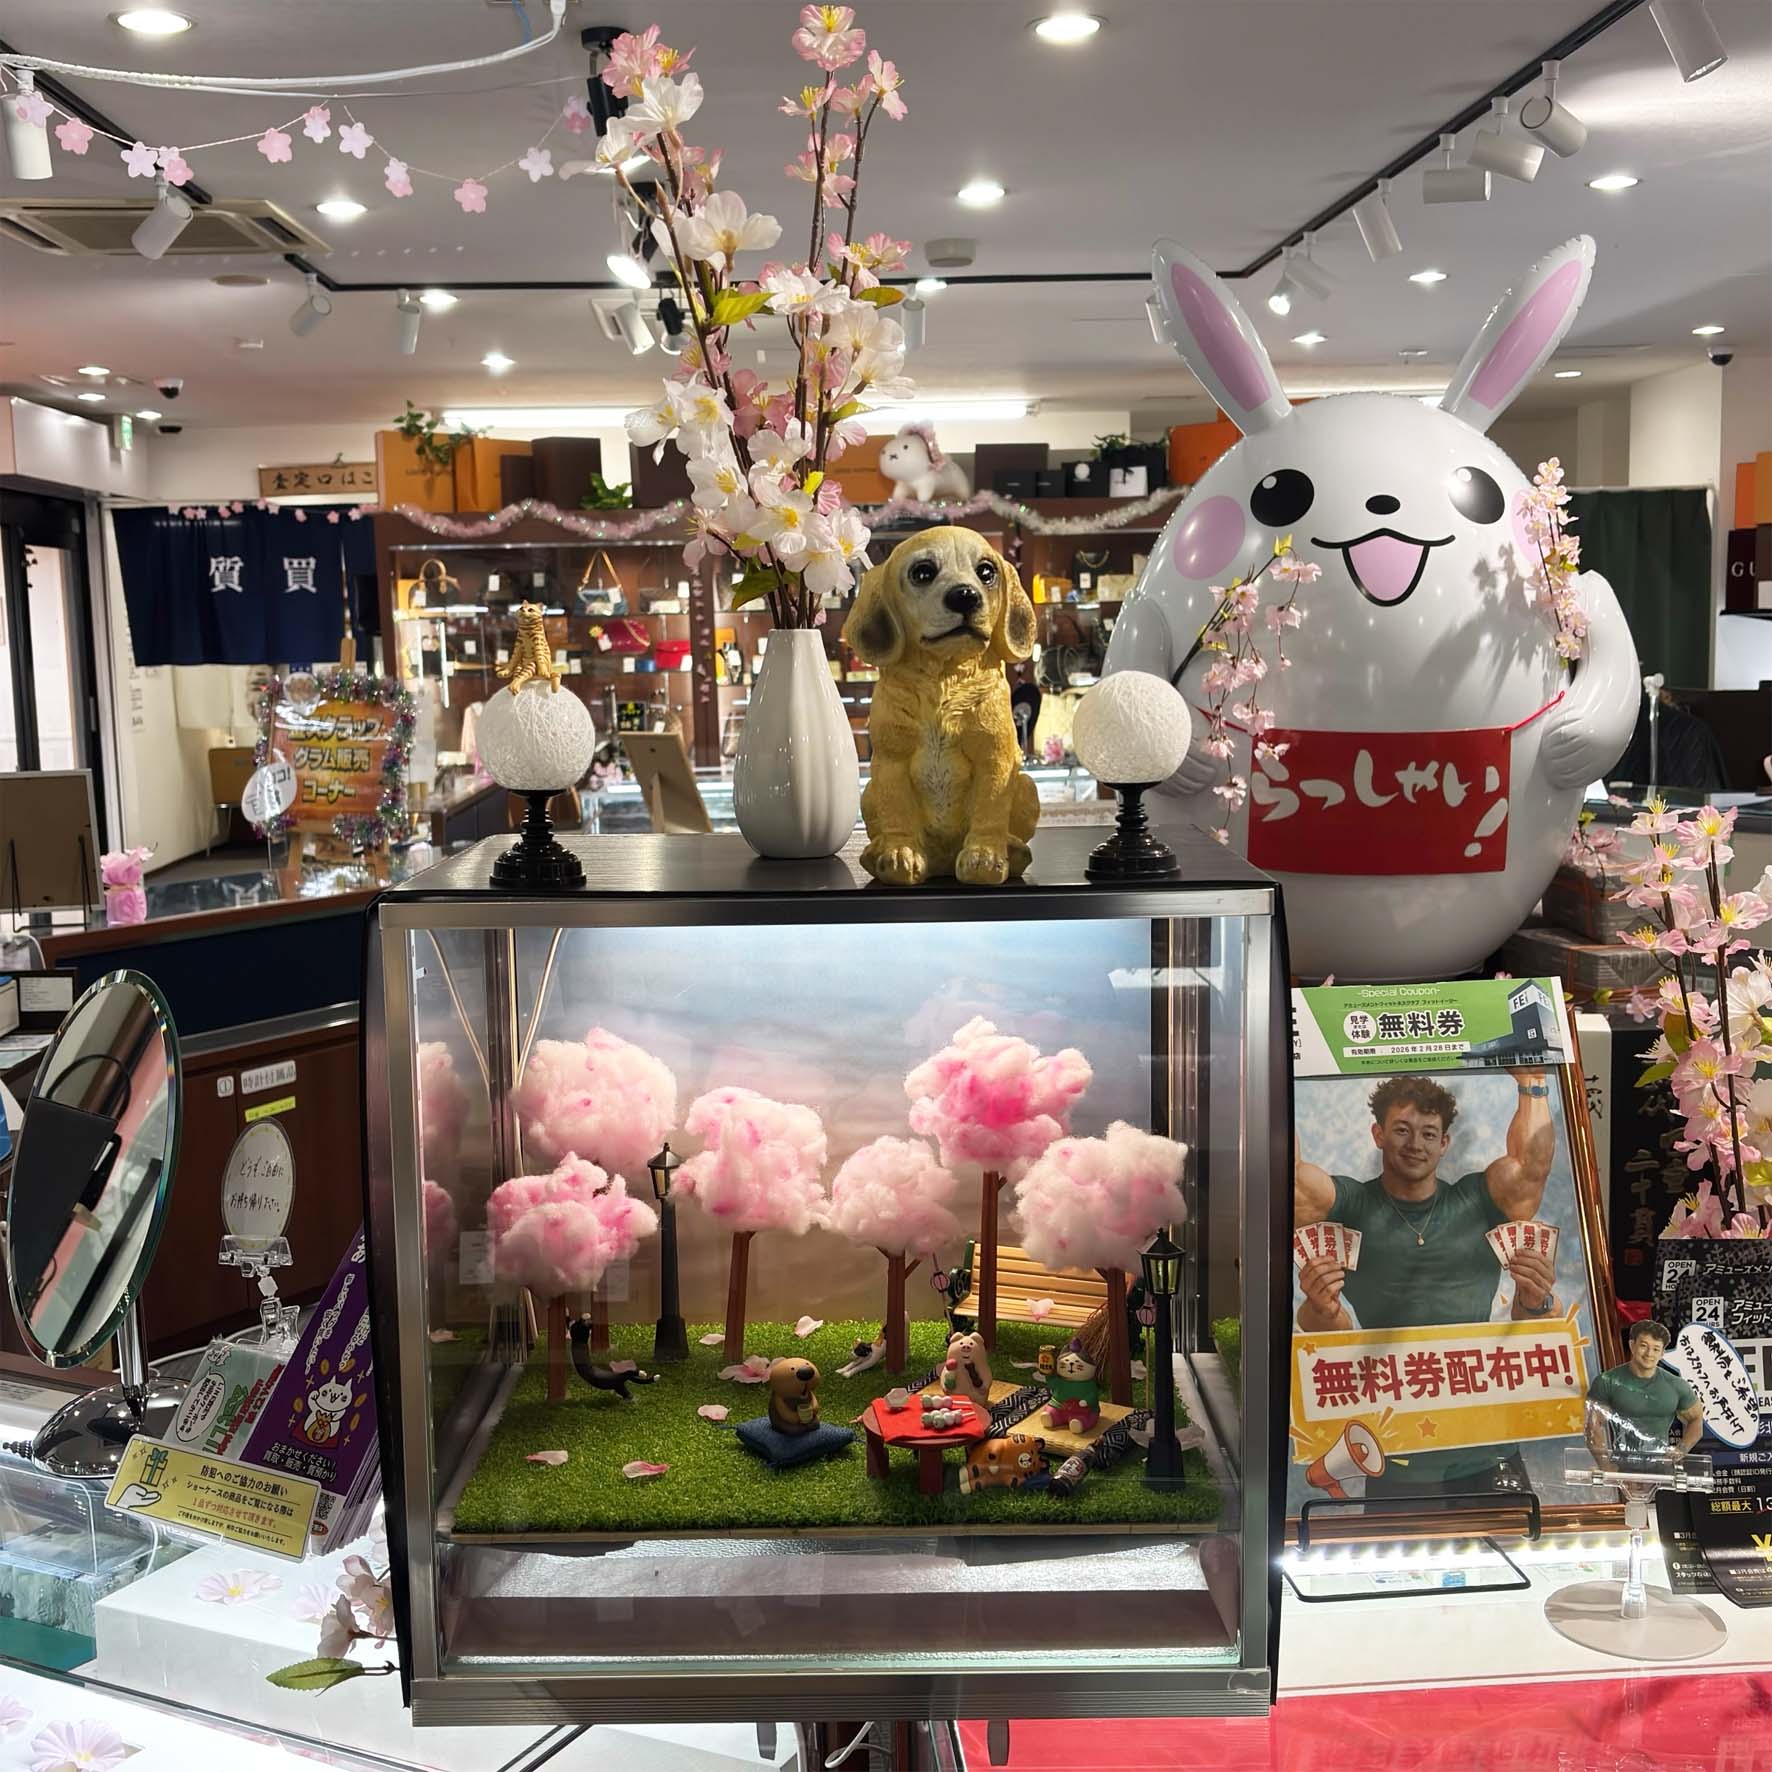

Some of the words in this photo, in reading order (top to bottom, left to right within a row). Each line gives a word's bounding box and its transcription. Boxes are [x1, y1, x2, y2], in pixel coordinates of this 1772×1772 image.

[209, 556, 243, 593] 質
[283, 556, 317, 594] 買
[294, 747, 371, 773] グラム販売
[302, 778, 356, 803] コーナー
[1350, 1015, 1369, 1025] 見学
[1378, 1010, 1464, 1040] 無料券
[1351, 1029, 1371, 1040] 体験
[1695, 1306, 1720, 1322] 24
[1312, 1343, 1575, 1409] 無料券配布中!
[200, 1465, 289, 1498] 防犯へのご協力のお願い
[1710, 1500, 1752, 1513] 総額最大
